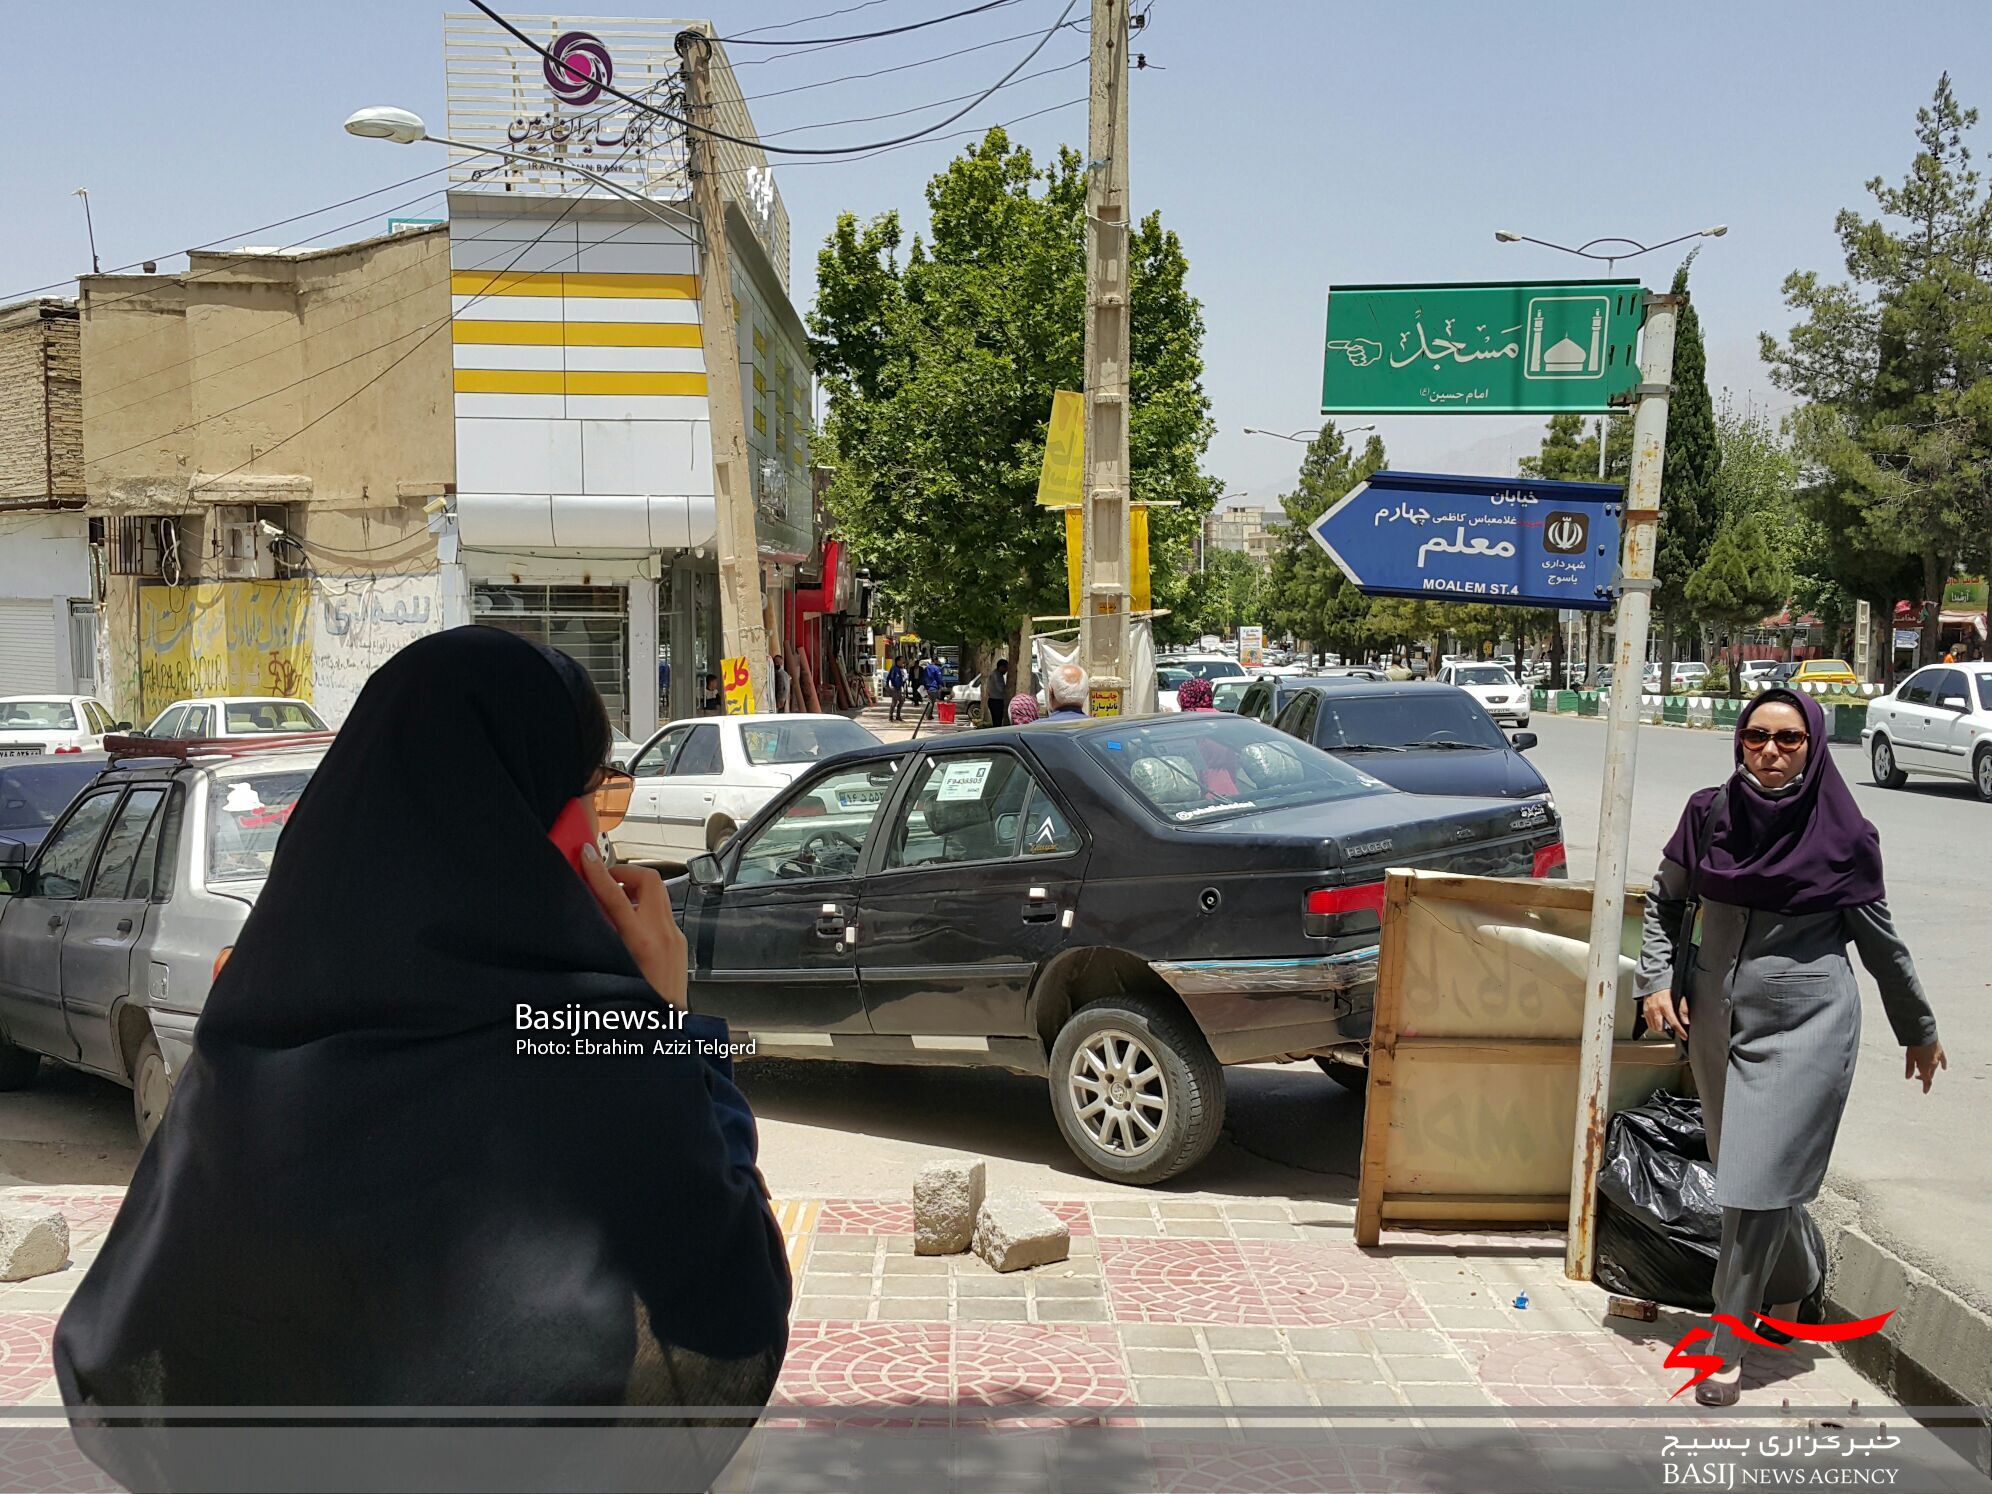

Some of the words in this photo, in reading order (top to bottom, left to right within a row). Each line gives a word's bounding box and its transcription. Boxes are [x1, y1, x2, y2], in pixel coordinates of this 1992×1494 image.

[508, 112, 550, 151] زمین
[550, 117, 600, 154] ایران
[596, 113, 644, 154] بانک
[528, 162, 553, 171] IRAN
[596, 164, 625, 172] BANK
[1465, 388, 1489, 404] امام
[1490, 489, 1538, 507] خیابان
[1375, 502, 1430, 526] چهارم
[1432, 512, 1467, 523] کاظمی
[1469, 513, 1517, 526] غلامعباس
[1417, 526, 1516, 568] معلم
[1541, 559, 1586, 571] شهرداری
[1423, 578, 1486, 594] MOALEM
[1489, 583, 1520, 596] ST.4
[1547, 574, 1578, 585] یاسوج
